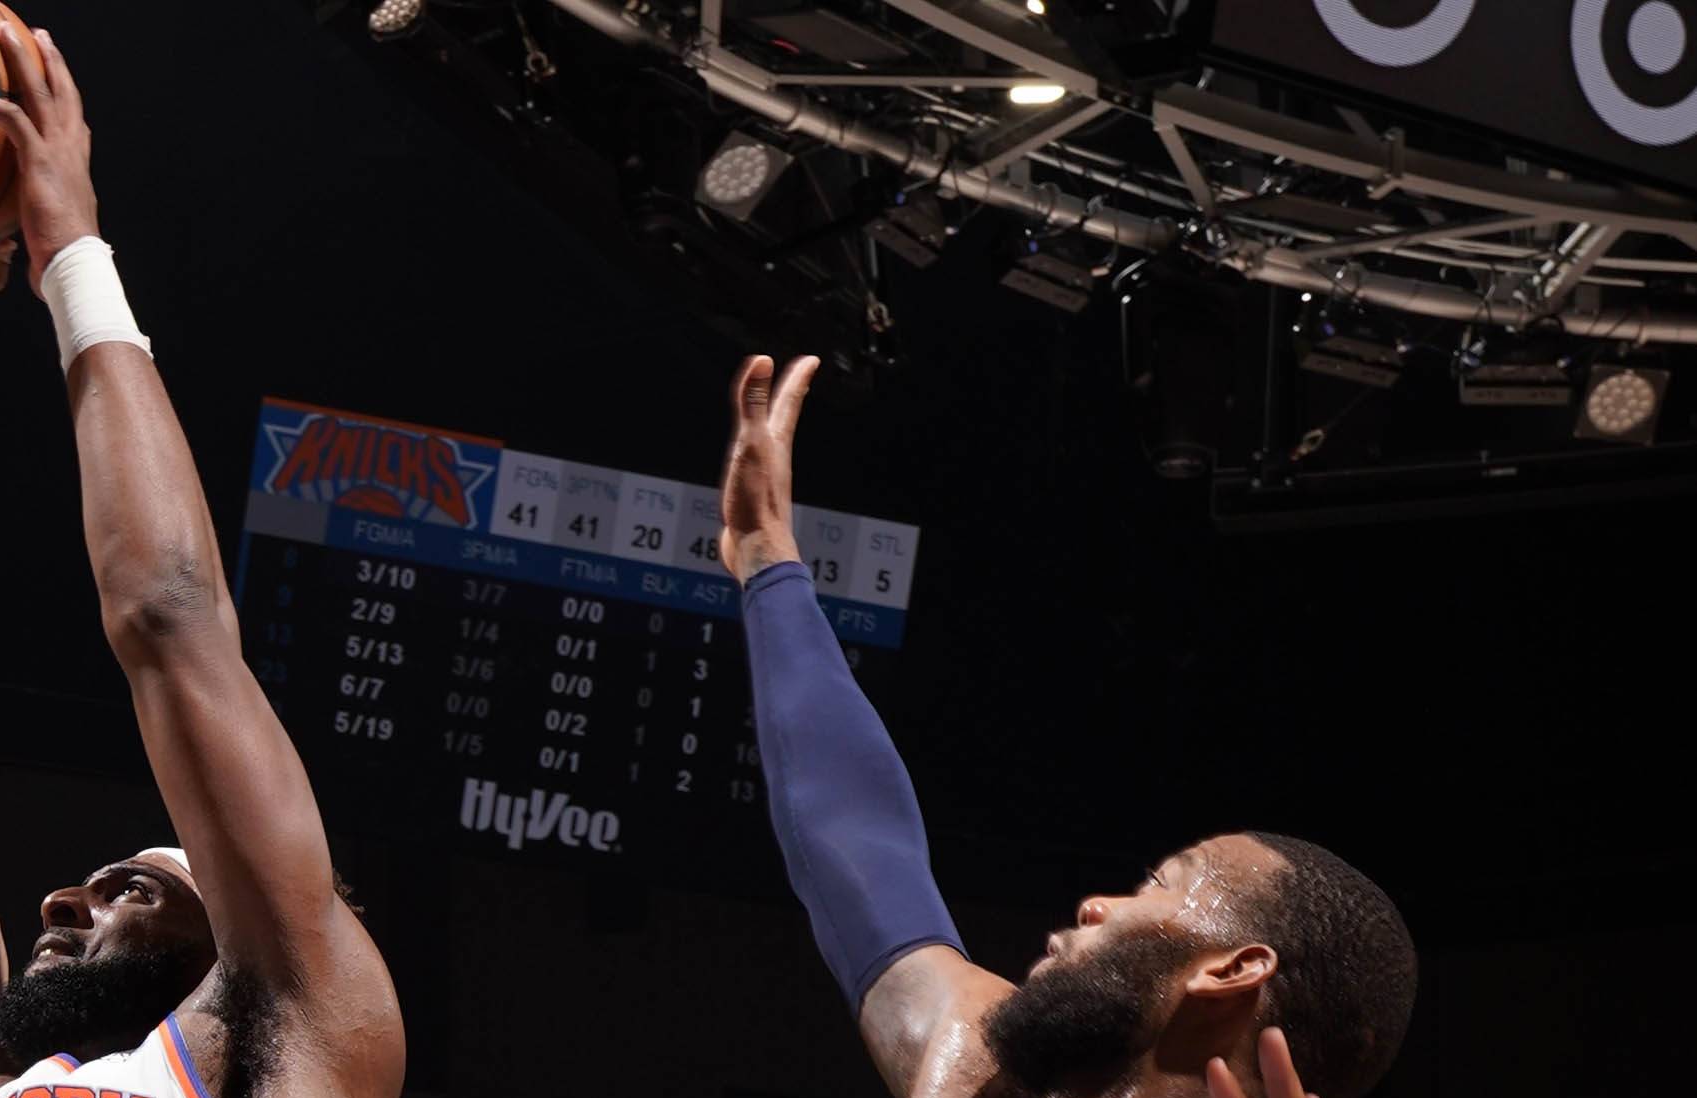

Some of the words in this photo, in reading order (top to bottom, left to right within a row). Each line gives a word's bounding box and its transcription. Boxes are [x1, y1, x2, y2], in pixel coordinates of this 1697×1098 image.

[272, 414, 471, 529] KNICKS
[507, 502, 539, 529] 41
[568, 513, 600, 540] 41
[631, 524, 664, 551] 20
[812, 557, 839, 583] 13
[875, 569, 892, 593] 5
[692, 499, 722, 521] RE
[870, 532, 905, 556] STL
[350, 597, 397, 625] 2/9
[459, 617, 501, 644] 1/4
[555, 634, 598, 662] 0/1
[692, 657, 709, 681] 3
[356, 559, 417, 591] 3/10
[462, 578, 508, 606] 3/7
[561, 597, 605, 625] 0/0
[648, 612, 664, 635] 0
[701, 621, 714, 645] 1
[691, 581, 732, 606] AST
[837, 605, 879, 633] PTS
[338, 672, 386, 700] 6/7
[445, 690, 491, 718] 0/0
[544, 708, 589, 737] 0/2
[634, 723, 646, 747] 1
[681, 732, 699, 756] 0
[344, 634, 407, 666] 5/13
[451, 655, 495, 682] 3/6
[550, 670, 594, 699] 0/0
[637, 686, 653, 709] 0
[689, 695, 702, 719] 1
[333, 709, 395, 741] 5/19
[443, 730, 485, 757] 1/5
[538, 745, 582, 774] 0/1
[674, 768, 694, 793] 2
[729, 779, 755, 804] 13
